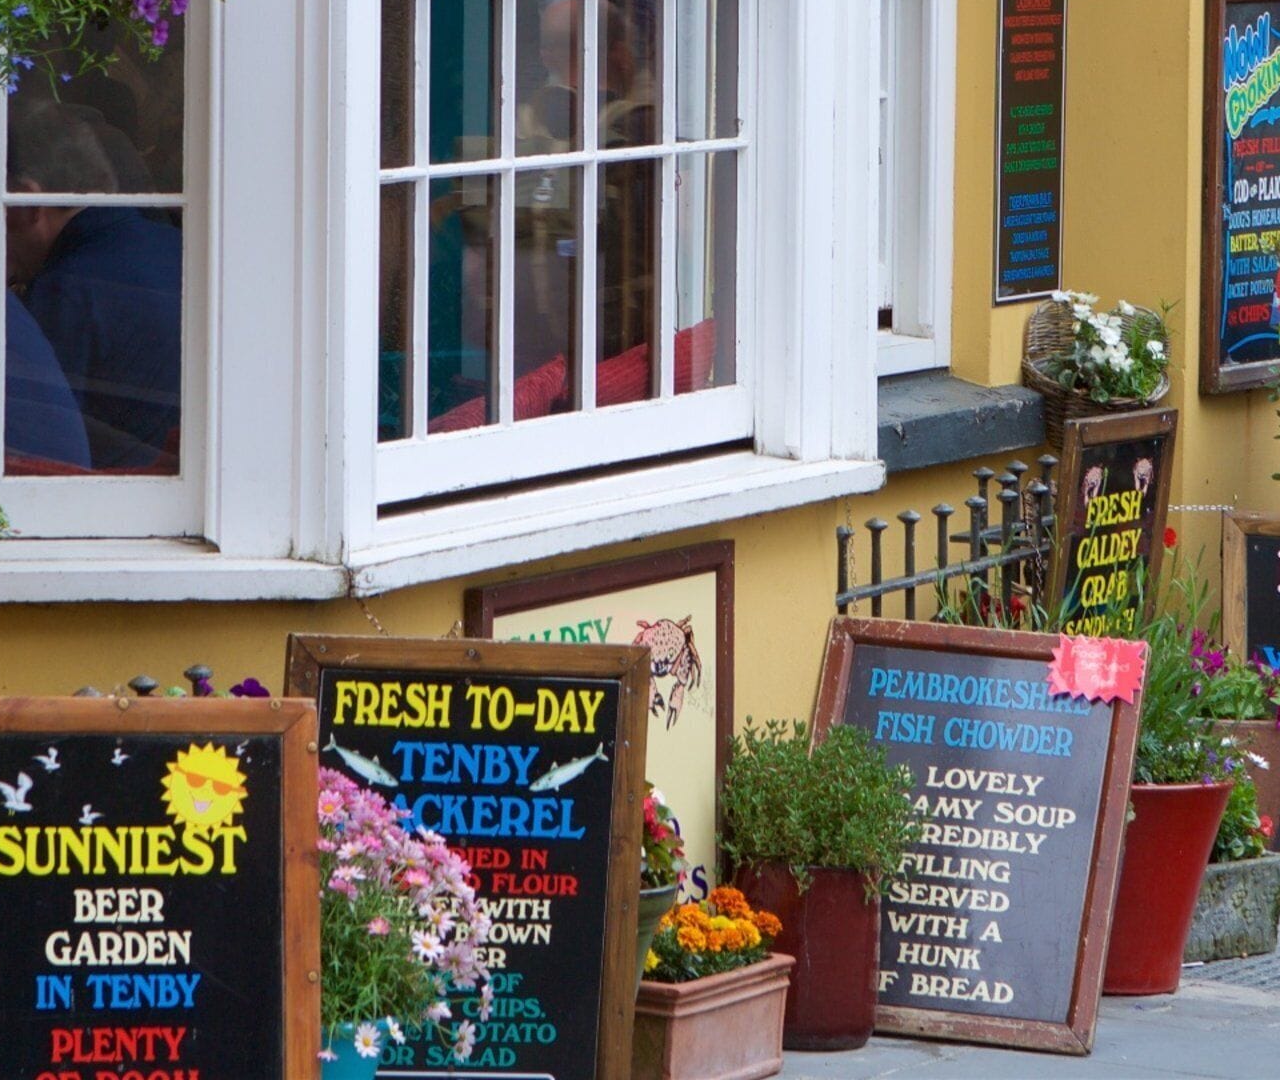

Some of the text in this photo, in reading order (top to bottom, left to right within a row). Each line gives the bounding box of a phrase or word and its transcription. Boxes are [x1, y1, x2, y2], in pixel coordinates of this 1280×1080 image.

[1085, 490, 1143, 529] FRESH
[1076, 528, 1142, 568] CALDEY
[1081, 570, 1128, 608] CRAB
[333, 680, 604, 734] FRESH TO-DAY
[874, 710, 1073, 757] FISH CHOWDER
[393, 740, 540, 786] TENBY
[926, 766, 1044, 796] LOVELY
[994, 801, 1076, 830] SOUP
[521, 849, 549, 870] IN
[897, 852, 1011, 883] FILLING
[492, 873, 578, 896] FLOUR
[888, 881, 1010, 912] SERVED
[73, 888, 164, 923] BEER
[478, 898, 551, 920] WITH
[887, 911, 1003, 943] WITH A
[45, 930, 191, 966] GARDEN
[897, 942, 981, 970] HUNK
[35, 973, 200, 1009] IN TENBY
[487, 973, 523, 993] OF
[910, 973, 1014, 1004] BREAD
[51, 1026, 186, 1063] PLENTY
[377, 1046, 414, 1066] OR
